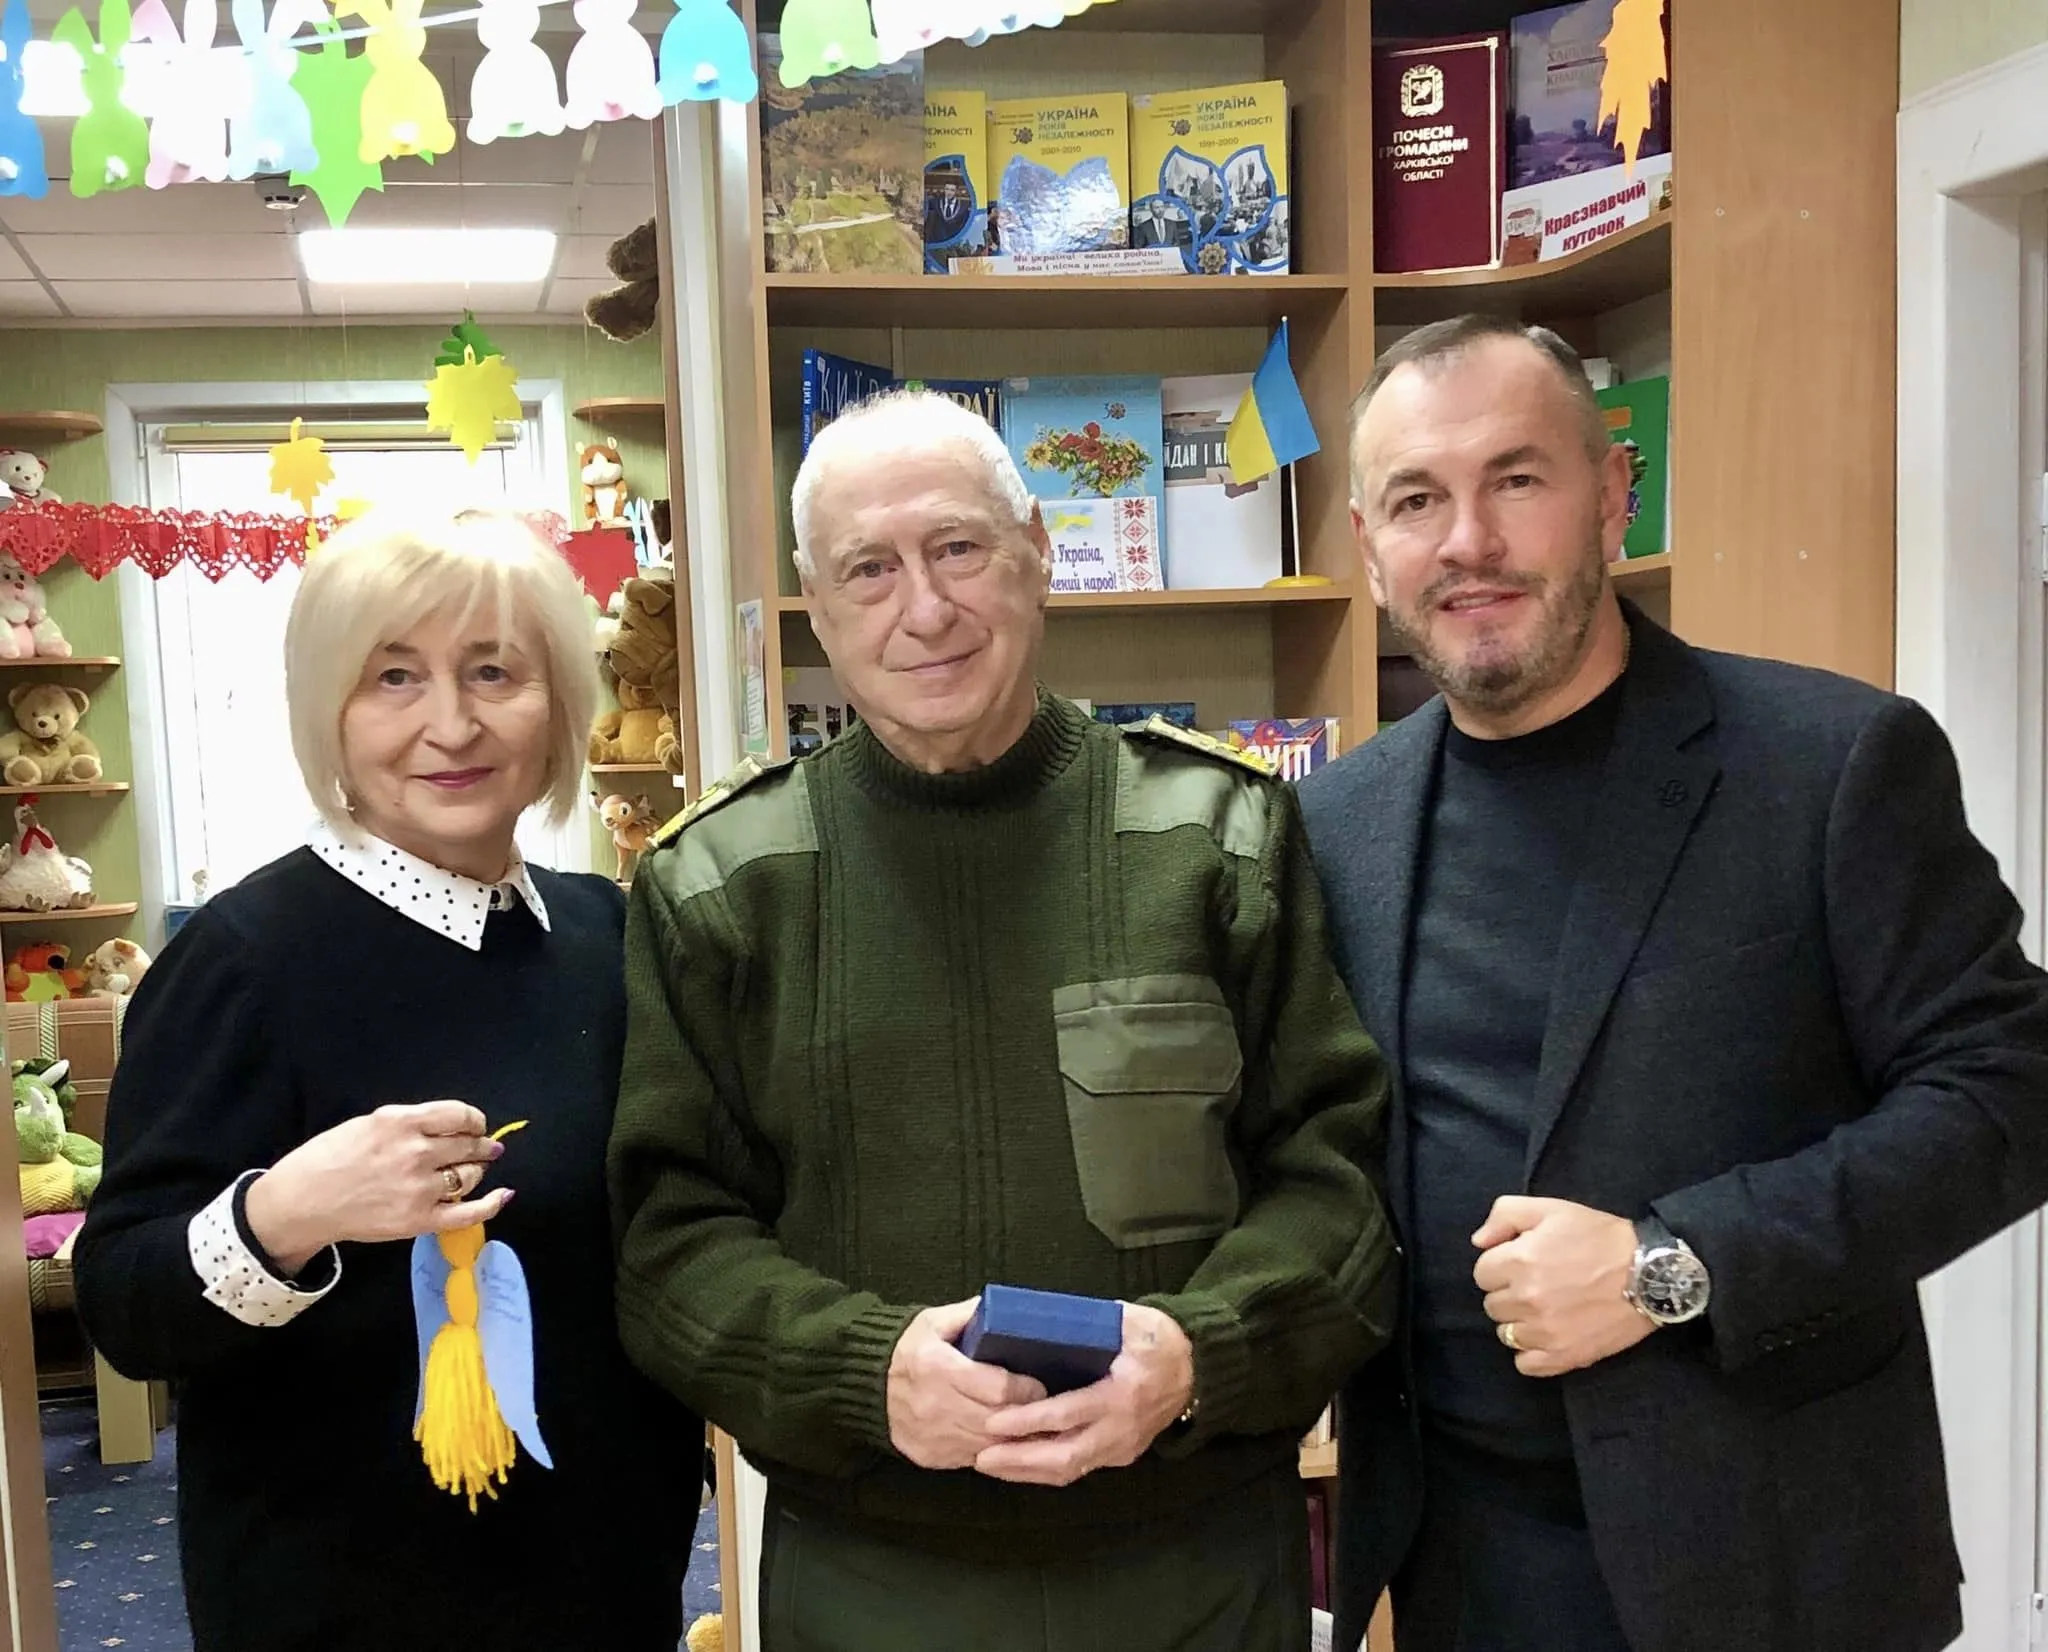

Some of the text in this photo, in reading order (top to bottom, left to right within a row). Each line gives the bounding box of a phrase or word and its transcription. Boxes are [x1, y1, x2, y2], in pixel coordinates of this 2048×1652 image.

[923, 102, 957, 117] АЇНА
[1037, 106, 1099, 122] УКРАЇНА
[1196, 95, 1257, 114] УКРАЇНА
[926, 127, 972, 136] ЕЖНОСТІ
[1198, 116, 1273, 132] НЕЗАЛЕЖНОСТІ
[1038, 128, 1114, 140] НЕЗАЛЕЖНОСТІ
[1393, 125, 1453, 144] ПОЧЕСНІ
[1379, 137, 1468, 159] ГРОМАДЯНИ
[1403, 168, 1444, 182] ОБЛАСТІ
[1545, 178, 1646, 236] Краєзнавчий
[1562, 215, 1625, 252] куточок
[803, 380, 812, 405] КИЇВ
[1164, 442, 1198, 469] ЙДАН
[1058, 541, 1104, 568] Україна,
[1084, 571, 1118, 593] народ!
